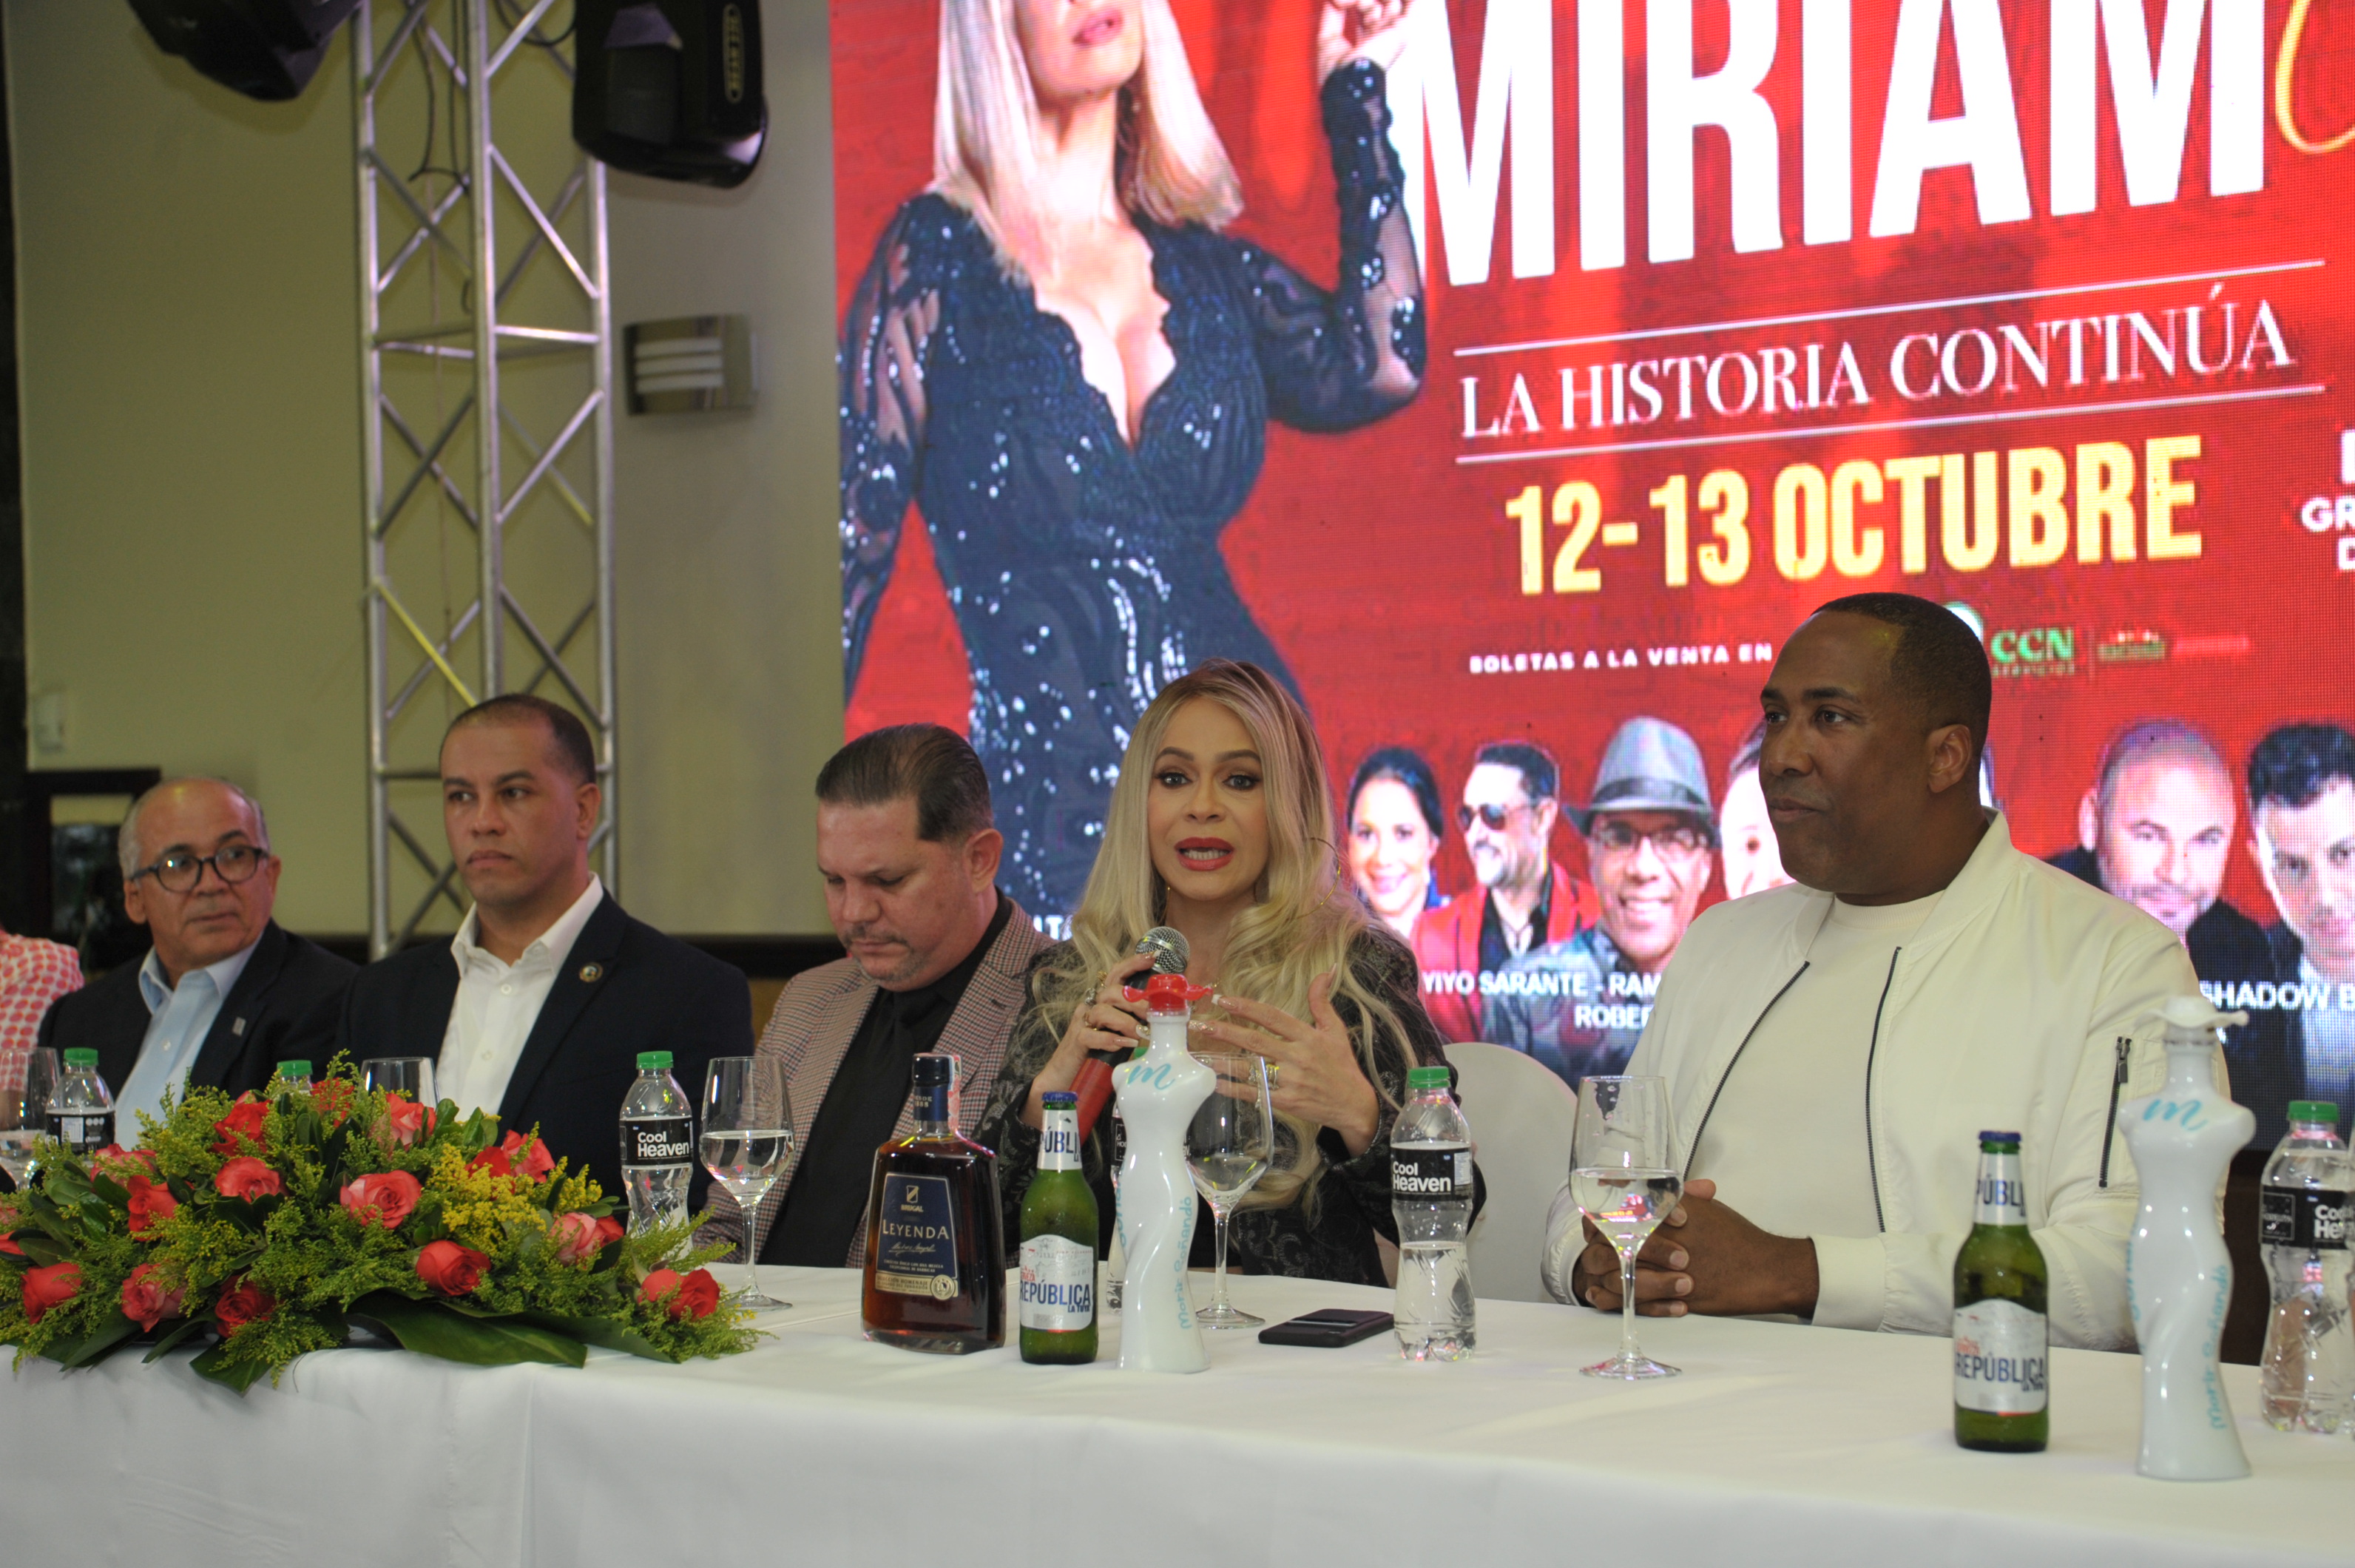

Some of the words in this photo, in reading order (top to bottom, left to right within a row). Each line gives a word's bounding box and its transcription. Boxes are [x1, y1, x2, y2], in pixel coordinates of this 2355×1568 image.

[1385, 0, 2265, 286] MIRIAM
[1459, 373, 1542, 439] LA
[1560, 343, 1869, 431] HISTORIA
[1891, 283, 2297, 400] CONTINÚA
[1772, 435, 2203, 581] OCTUBRE
[1470, 651, 1576, 674] BOLETAS
[1584, 650, 1600, 669] A
[1606, 649, 1639, 669] LA
[1646, 645, 1730, 667] VENTA
[1737, 643, 1773, 663] EN
[1990, 627, 2075, 663] CCN
[1423, 970, 1475, 995] YIYO
[1479, 971, 1589, 997] SARANTE
[637, 1131, 667, 1143] Cool
[637, 1141, 689, 1158] Heaven
[1393, 1160, 1419, 1175] Cool
[1393, 1174, 1451, 1192] Heaven
[901, 1204, 924, 1212] BRUGAL
[882, 1219, 950, 1240] LEYENDA
[1021, 1278, 1091, 1307] REPÚBLICA
